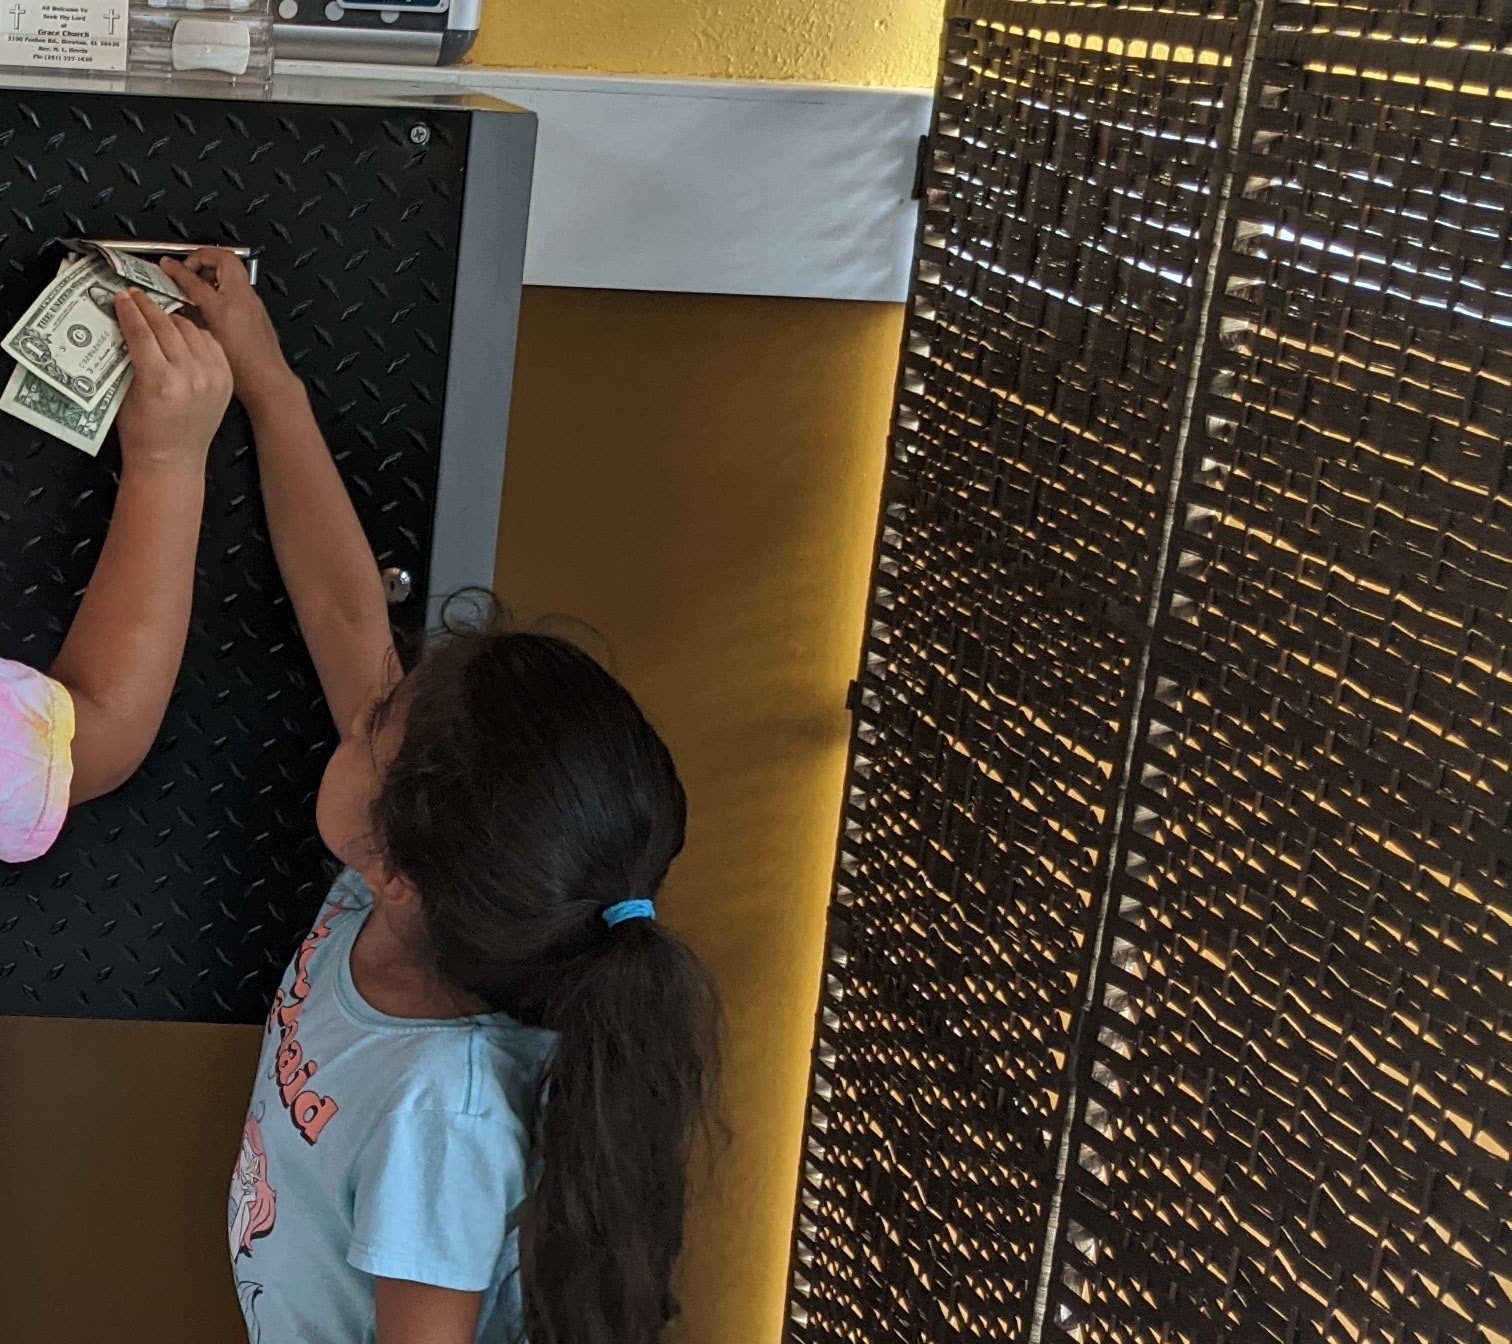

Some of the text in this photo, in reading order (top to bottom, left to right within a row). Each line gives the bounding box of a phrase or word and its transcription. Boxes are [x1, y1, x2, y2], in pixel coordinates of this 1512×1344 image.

[38, 29, 90, 38] Grace Church
[37, 311, 54, 330] THE
